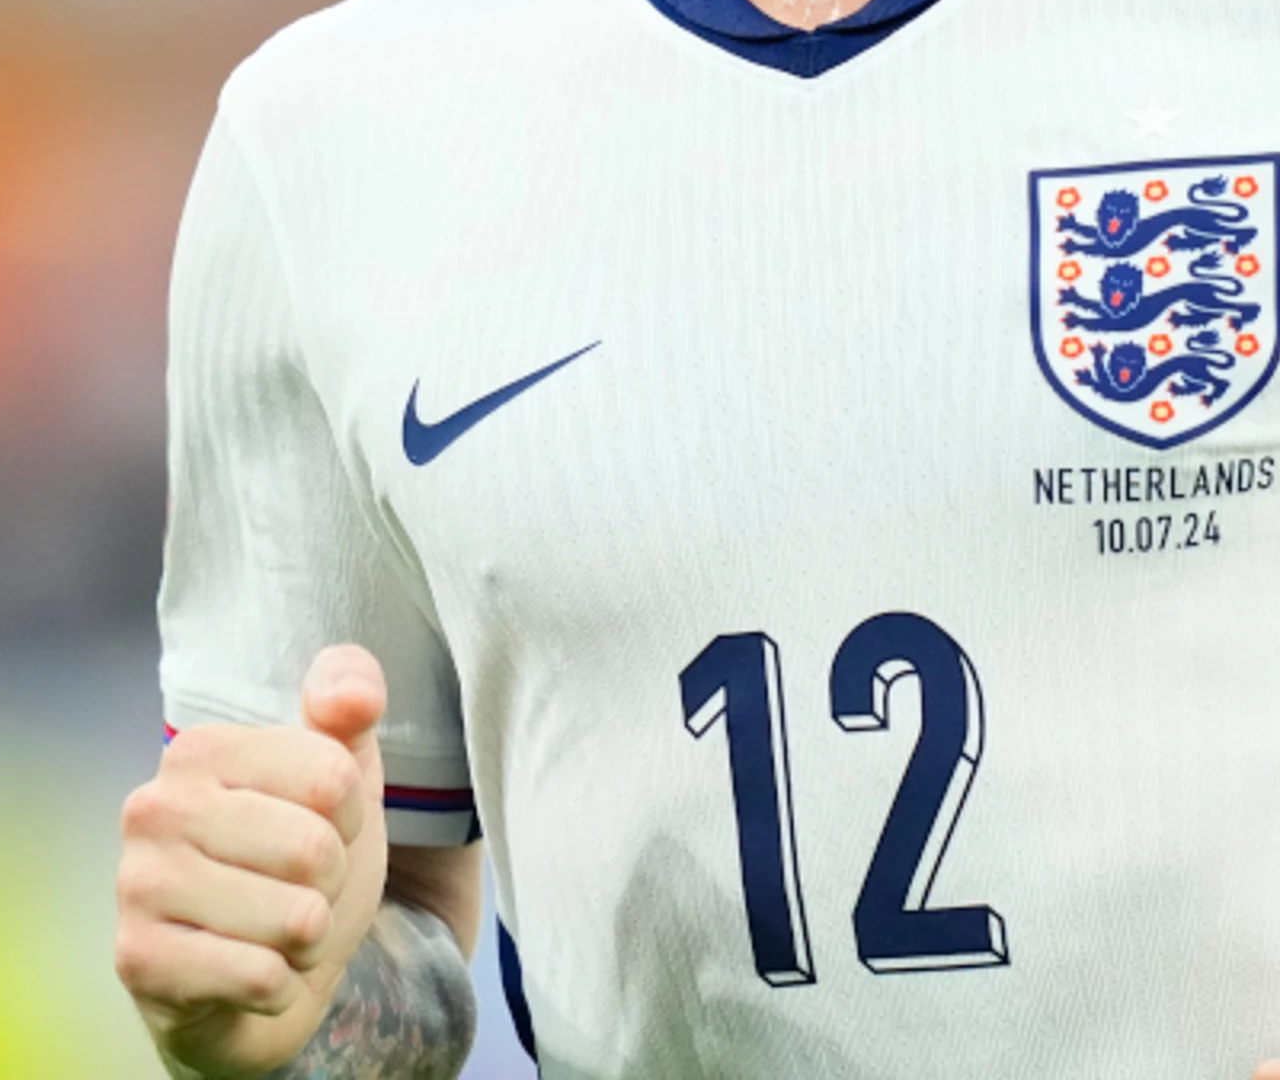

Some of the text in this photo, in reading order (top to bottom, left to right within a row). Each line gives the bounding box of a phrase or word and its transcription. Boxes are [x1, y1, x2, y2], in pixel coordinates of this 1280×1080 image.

[1034, 456, 1276, 505] NETHERLANDS
[1094, 510, 1221, 555] 10.07.24
[678, 611, 1010, 987] 12
